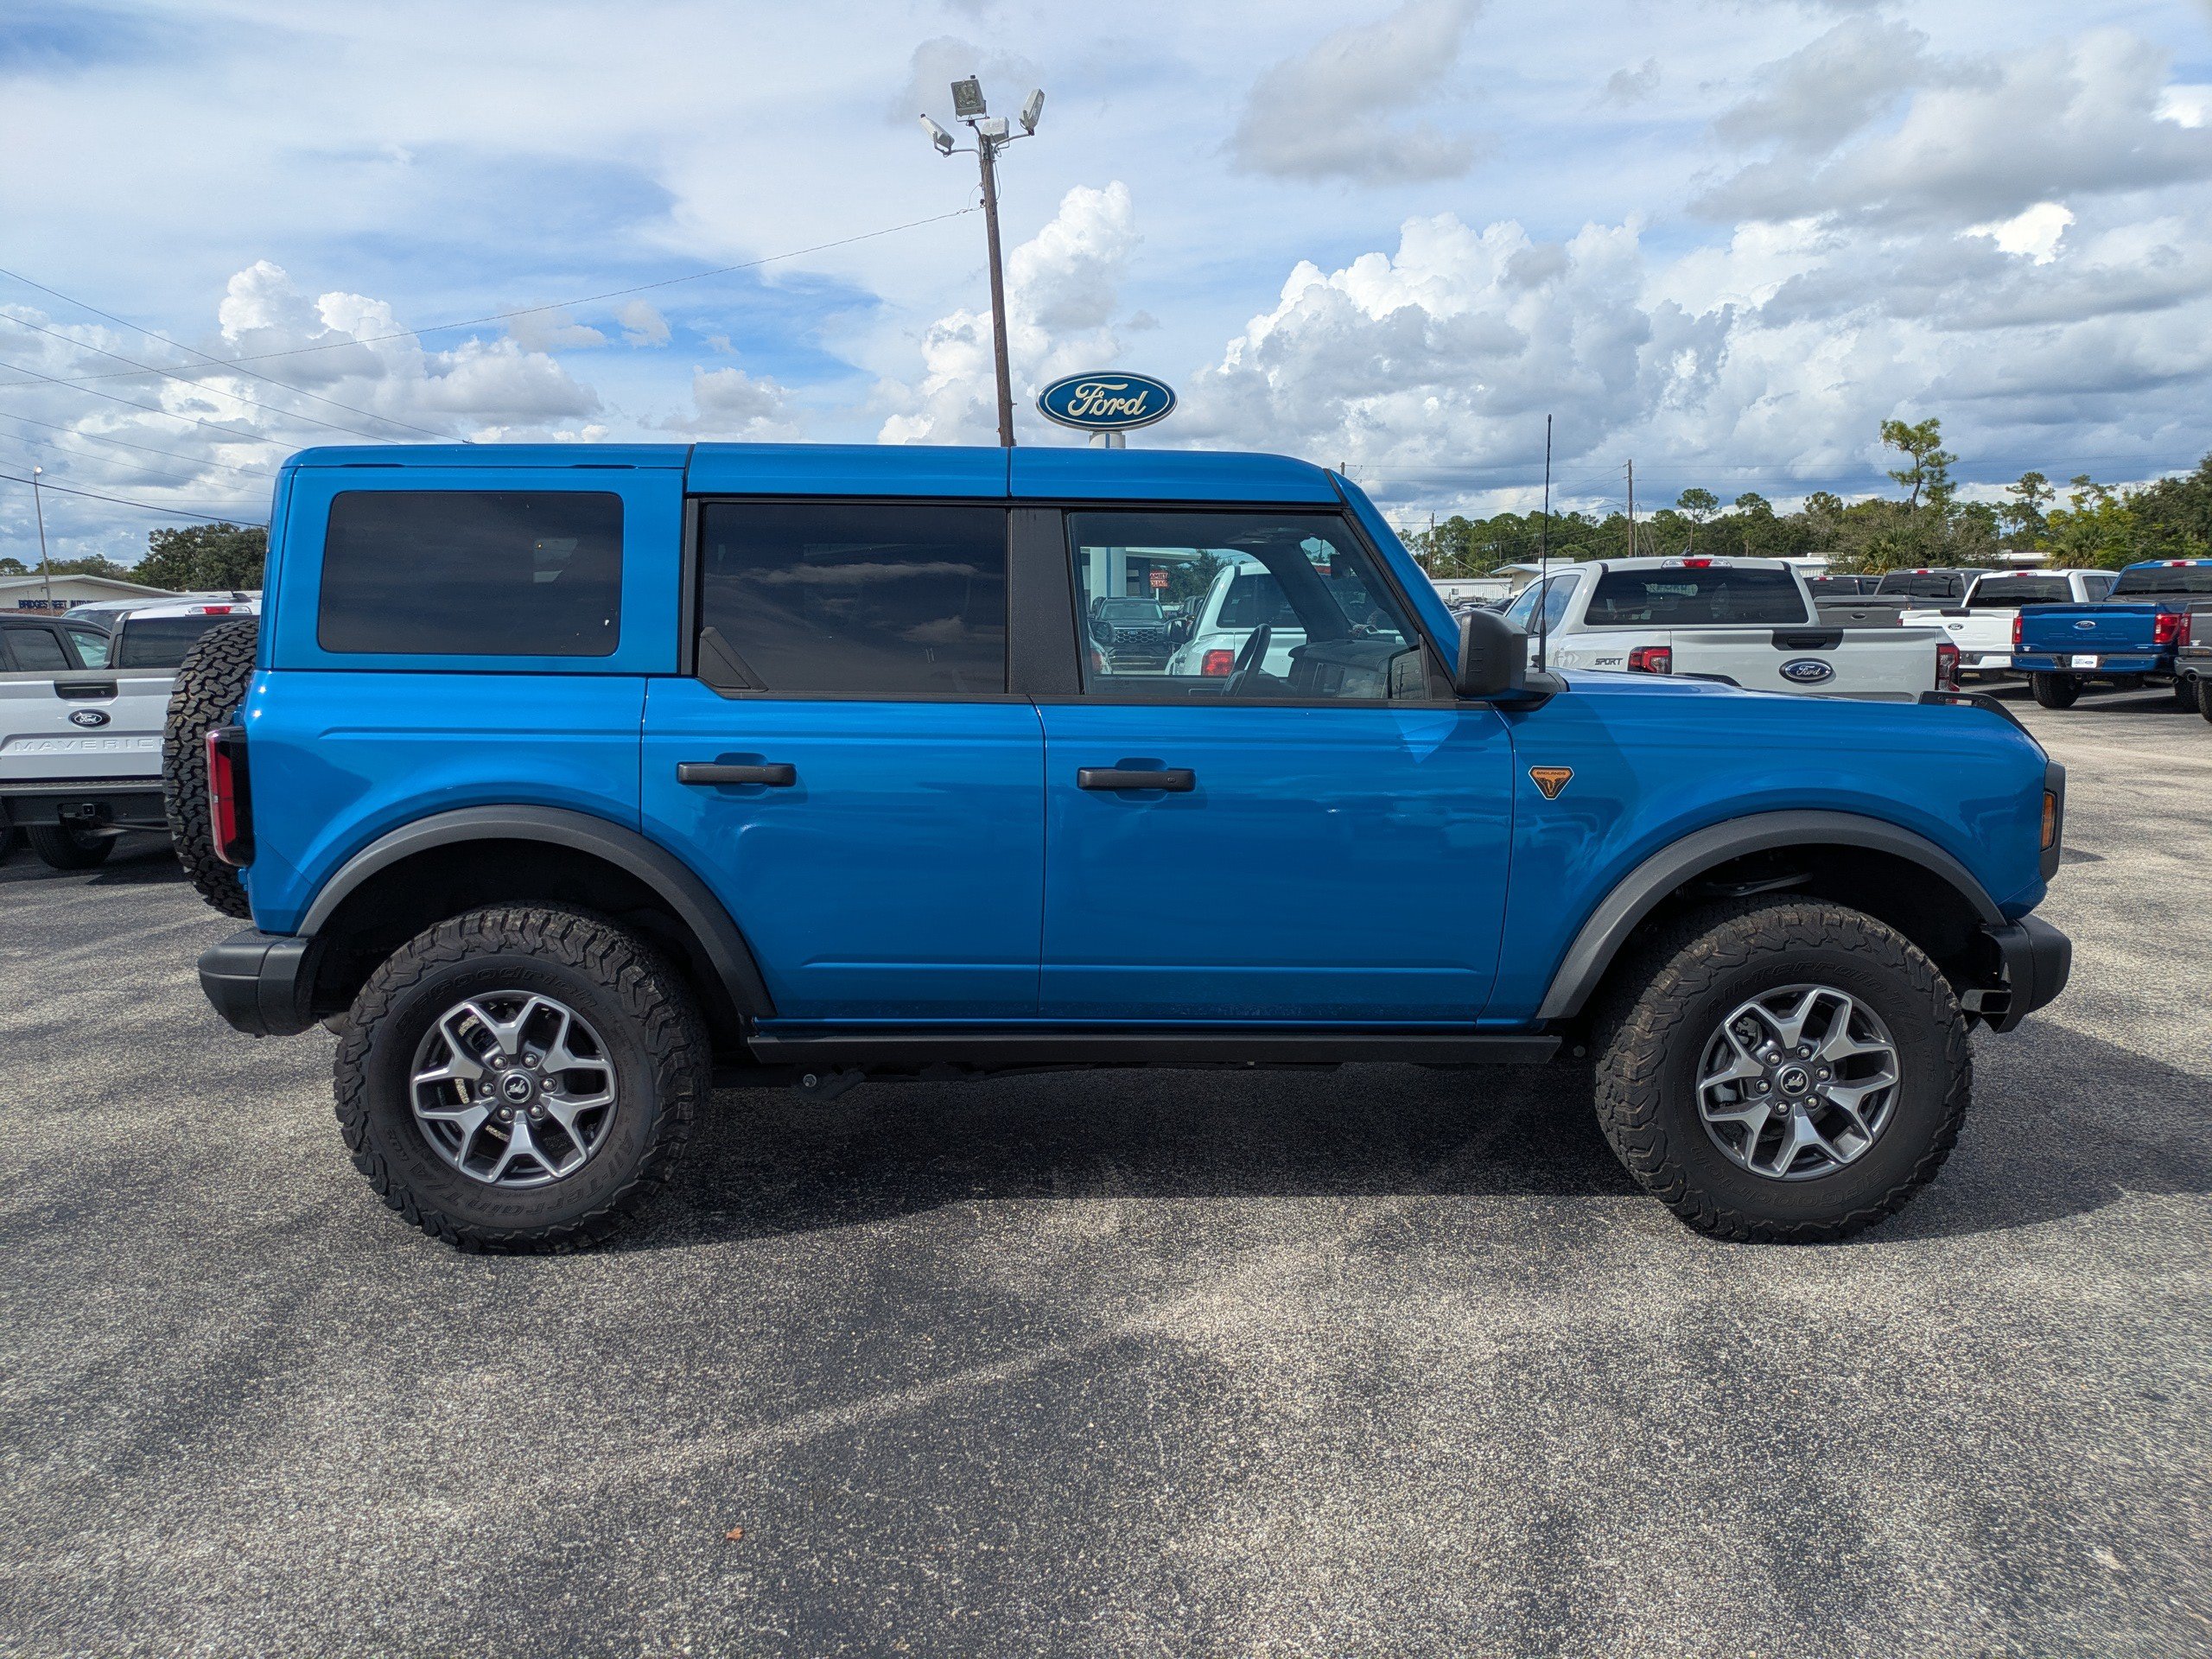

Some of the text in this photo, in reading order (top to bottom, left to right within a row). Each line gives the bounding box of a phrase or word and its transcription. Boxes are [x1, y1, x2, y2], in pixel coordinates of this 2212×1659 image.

[1067, 382, 1149, 416] Ford
[18, 600, 67, 608] BRIDGESREET
[1796, 664, 1821, 676] Ford
[79, 714, 98, 723] Ford
